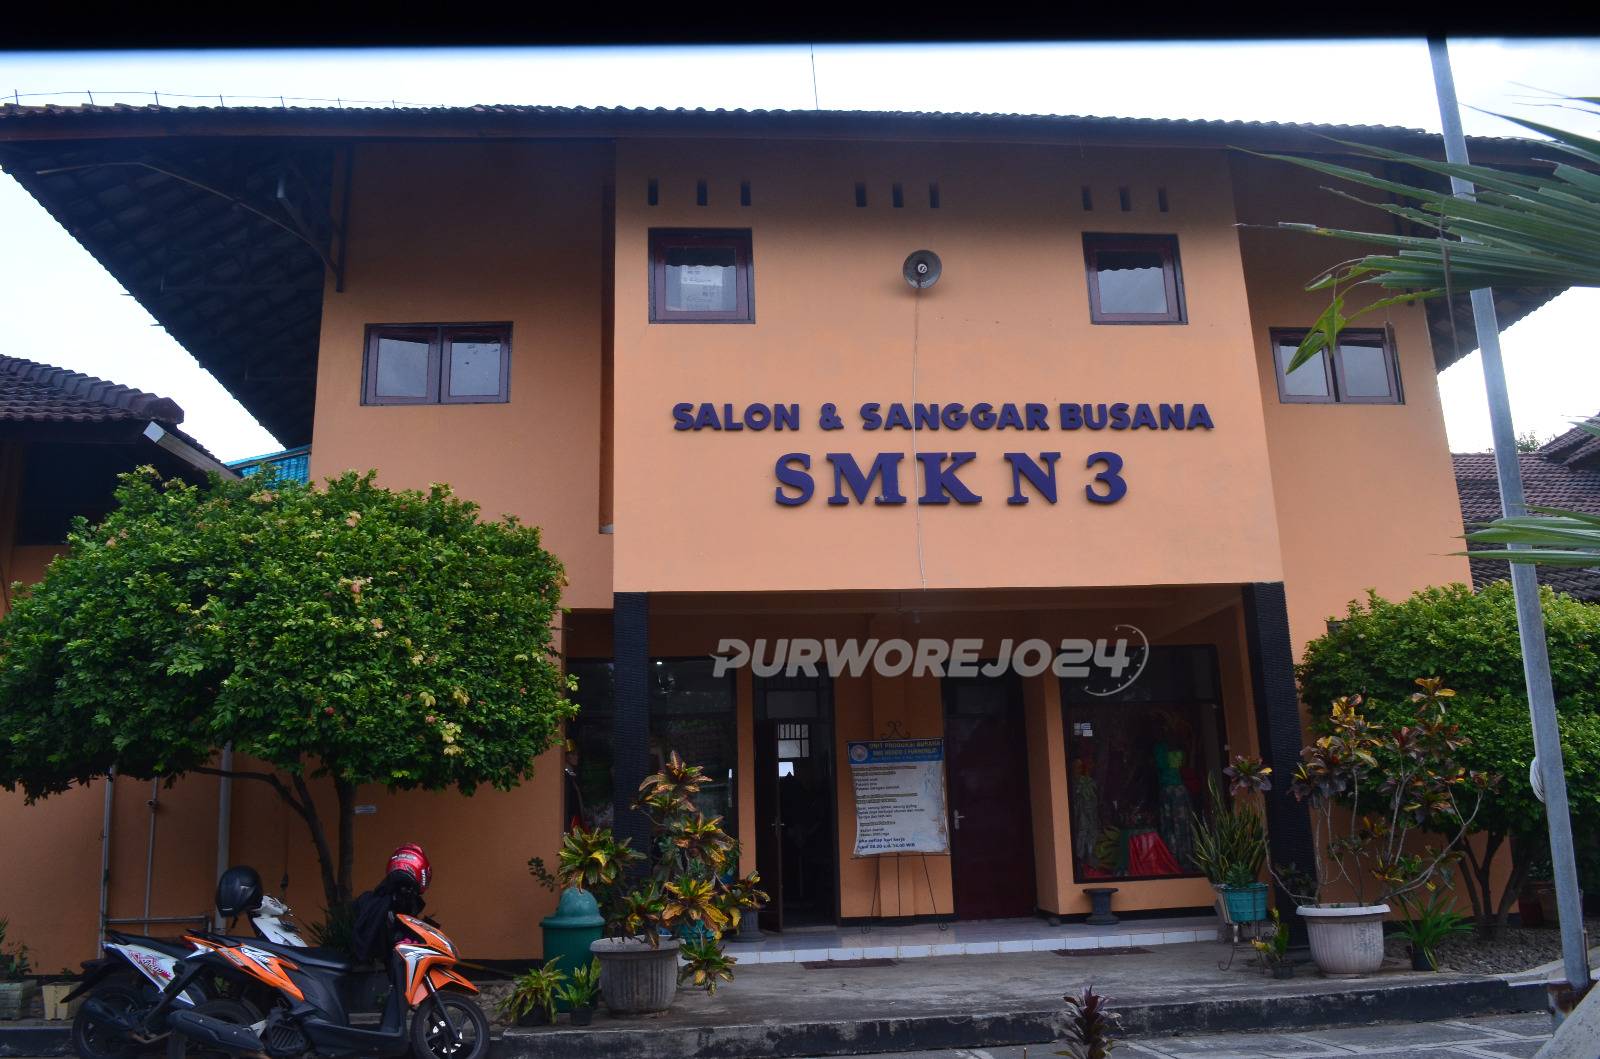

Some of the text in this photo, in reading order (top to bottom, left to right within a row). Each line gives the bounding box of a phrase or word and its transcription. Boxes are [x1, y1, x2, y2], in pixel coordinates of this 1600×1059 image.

[672, 402, 1214, 430] SALON & SANGGAR BUSANA
[775, 452, 1128, 505] SMK N 3
